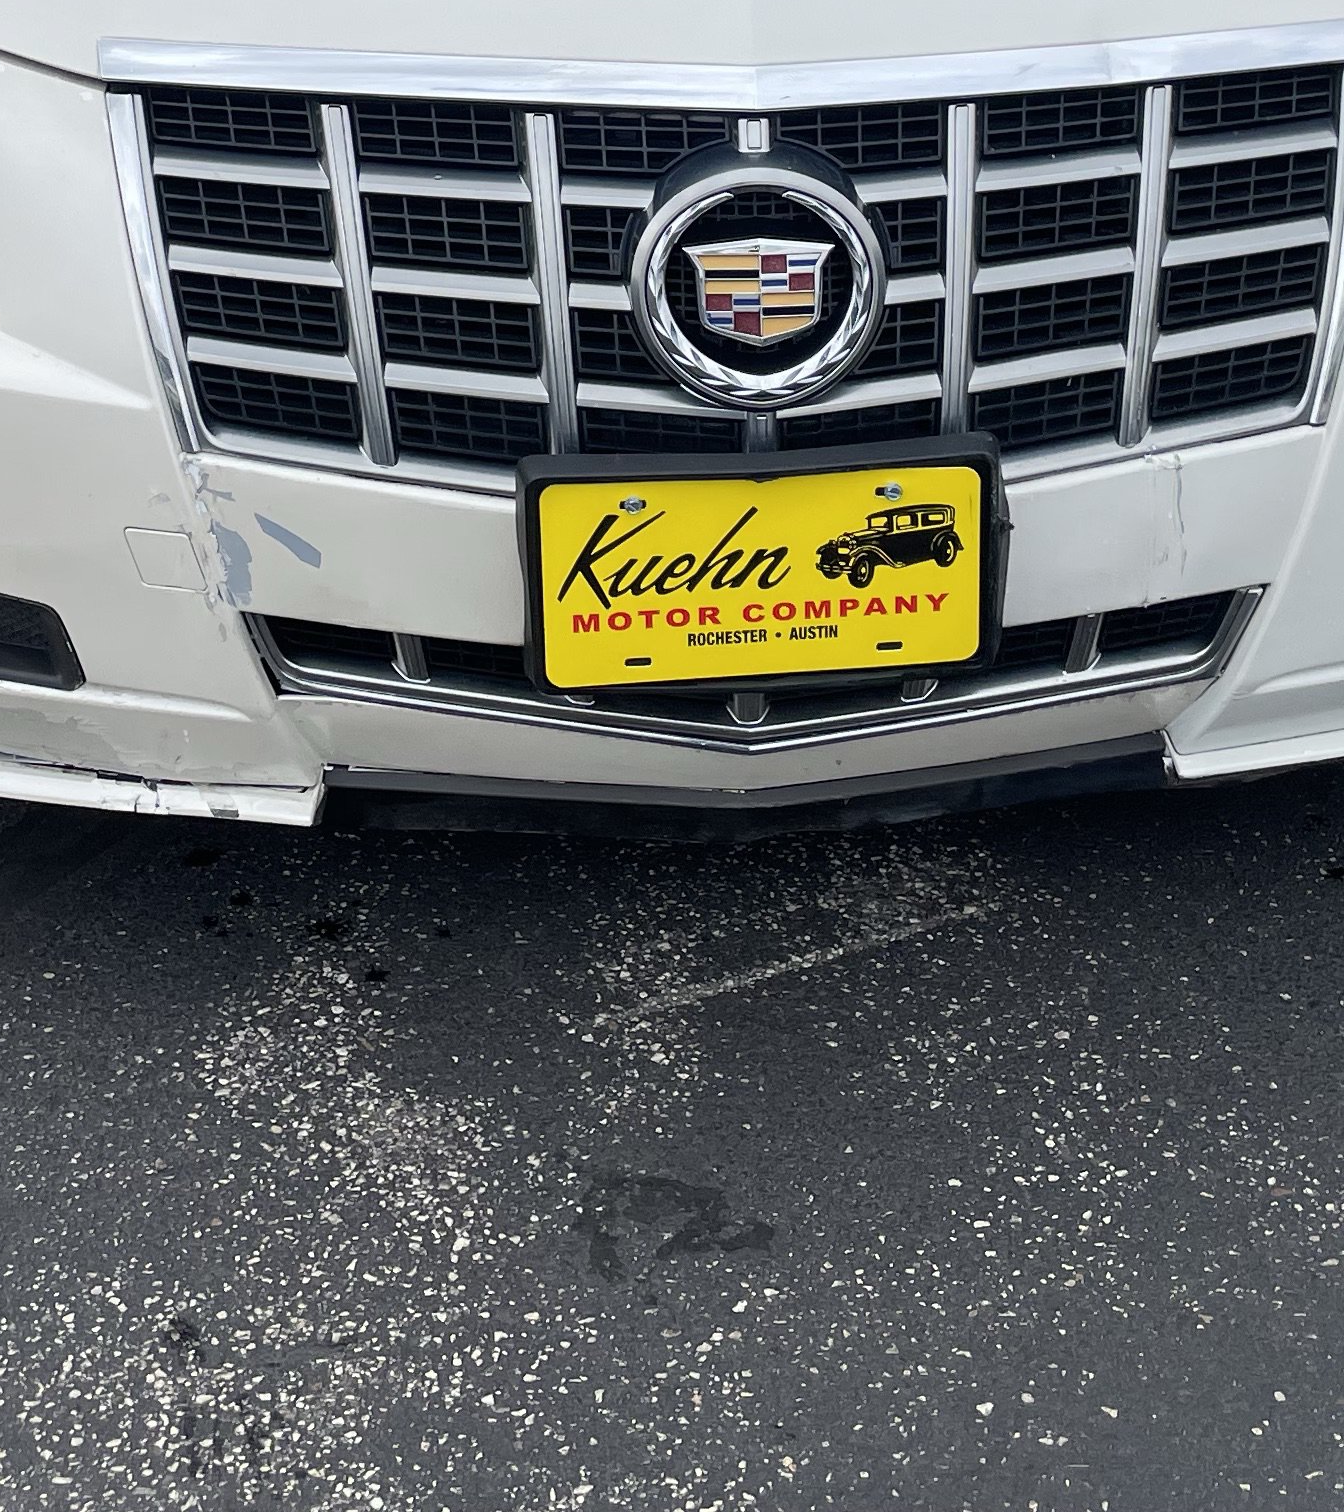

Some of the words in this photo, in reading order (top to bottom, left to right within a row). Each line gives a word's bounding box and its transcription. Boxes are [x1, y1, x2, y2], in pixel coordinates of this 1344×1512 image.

[557, 506, 792, 609] Kuehn
[572, 606, 721, 634] MOTOR
[742, 592, 950, 623] COMPANY
[687, 628, 768, 647] ROCHESTER
[788, 624, 839, 641] AUSTIN
